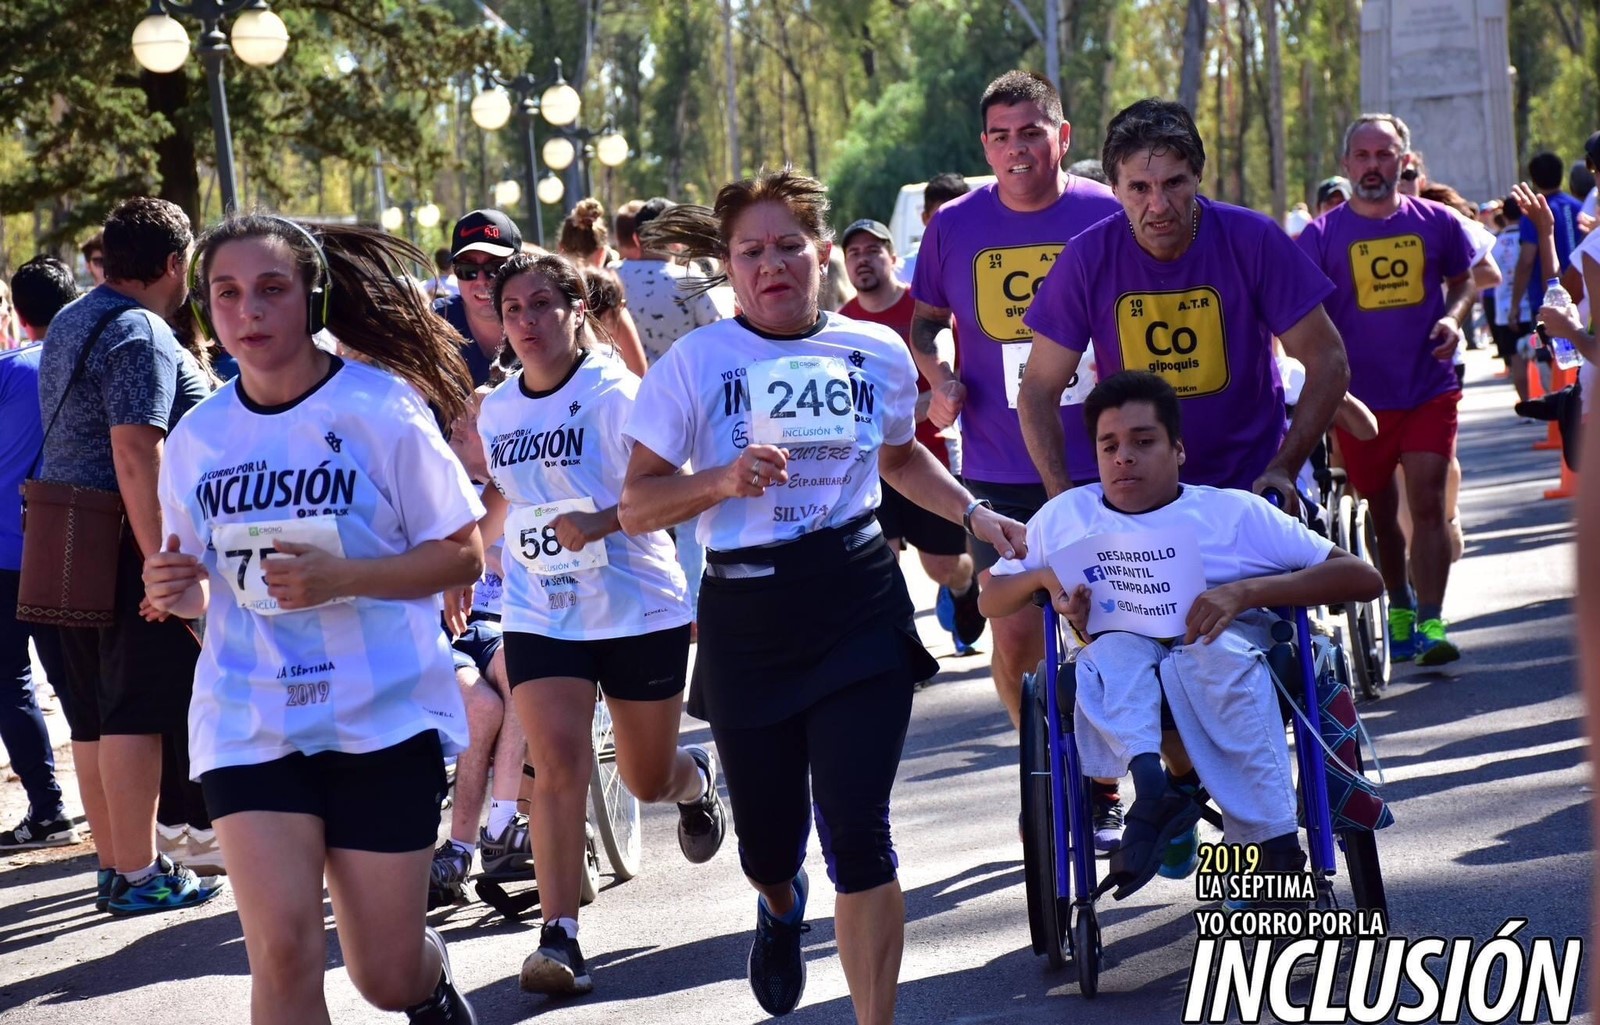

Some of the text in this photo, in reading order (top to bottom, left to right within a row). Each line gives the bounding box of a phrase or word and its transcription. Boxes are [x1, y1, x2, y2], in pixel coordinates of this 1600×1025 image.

[1371, 256, 1408, 280] Co
[1373, 280, 1409, 292] gipoquis
[1130, 299, 1142, 308] 10
[1178, 298, 1210, 311] A.T.R
[1131, 308, 1143, 317] 21
[1145, 321, 1197, 356] Co
[1149, 358, 1199, 373] gipoquis
[721, 370, 733, 381] YO
[767, 378, 852, 419] 246
[782, 425, 831, 437] INCLUSIÓN
[207, 467, 235, 480] CORRO
[236, 462, 254, 474] POR
[256, 460, 267, 471] LA
[196, 460, 357, 520] INCLUSIÓN
[1097, 547, 1176, 563] DESARROLLO
[1104, 565, 1154, 579] INFANTIL
[1109, 580, 1171, 595] TEMPRANO
[549, 591, 577, 610] 2019
[286, 681, 330, 706] 2019
